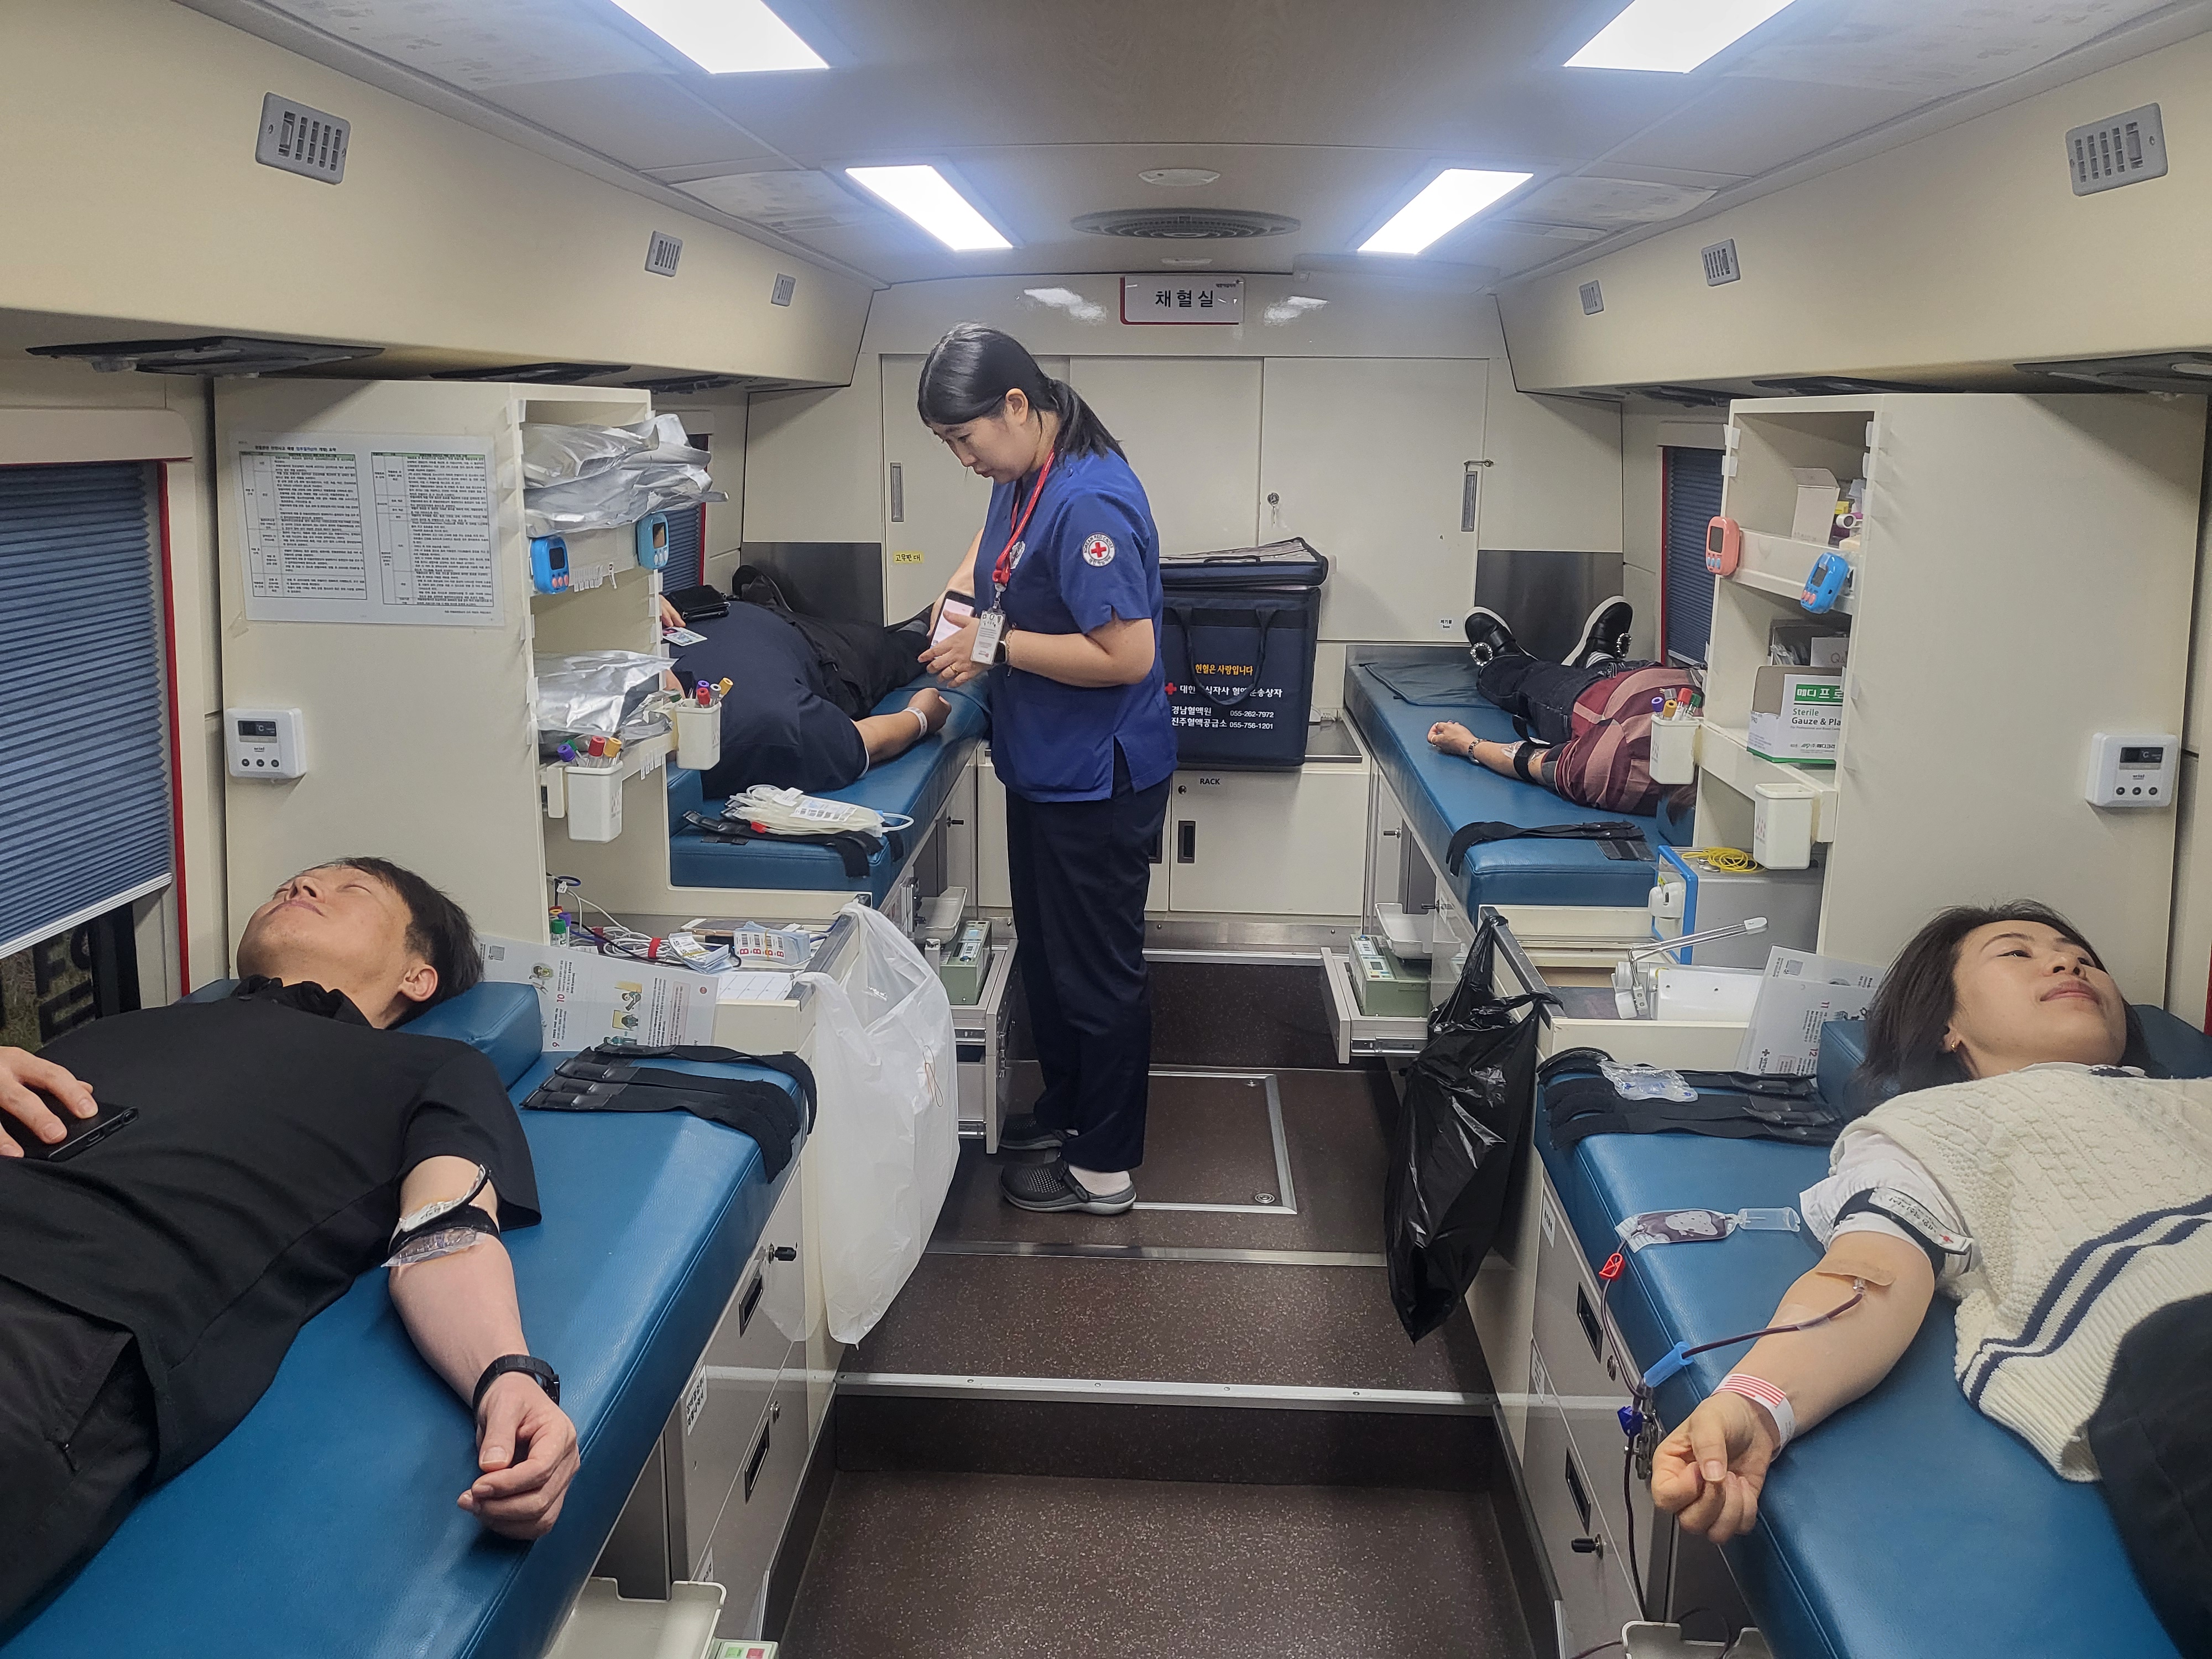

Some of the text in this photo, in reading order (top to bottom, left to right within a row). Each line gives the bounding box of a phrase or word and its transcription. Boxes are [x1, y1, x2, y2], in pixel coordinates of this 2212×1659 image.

[1155, 289, 1214, 308] 채혈실
[1195, 664, 1254, 676] 헌혈은 사랑입니다
[1180, 685, 1230, 696] 대한십자사
[1171, 706, 1212, 716] 경남혈액원
[1792, 708, 1819, 716] Sterile
[1171, 717, 1228, 728] 진주혈액공급소
[556, 993, 565, 1003] 10
[1820, 1001, 1829, 1009] 11
[1809, 1048, 1818, 1057] 12
